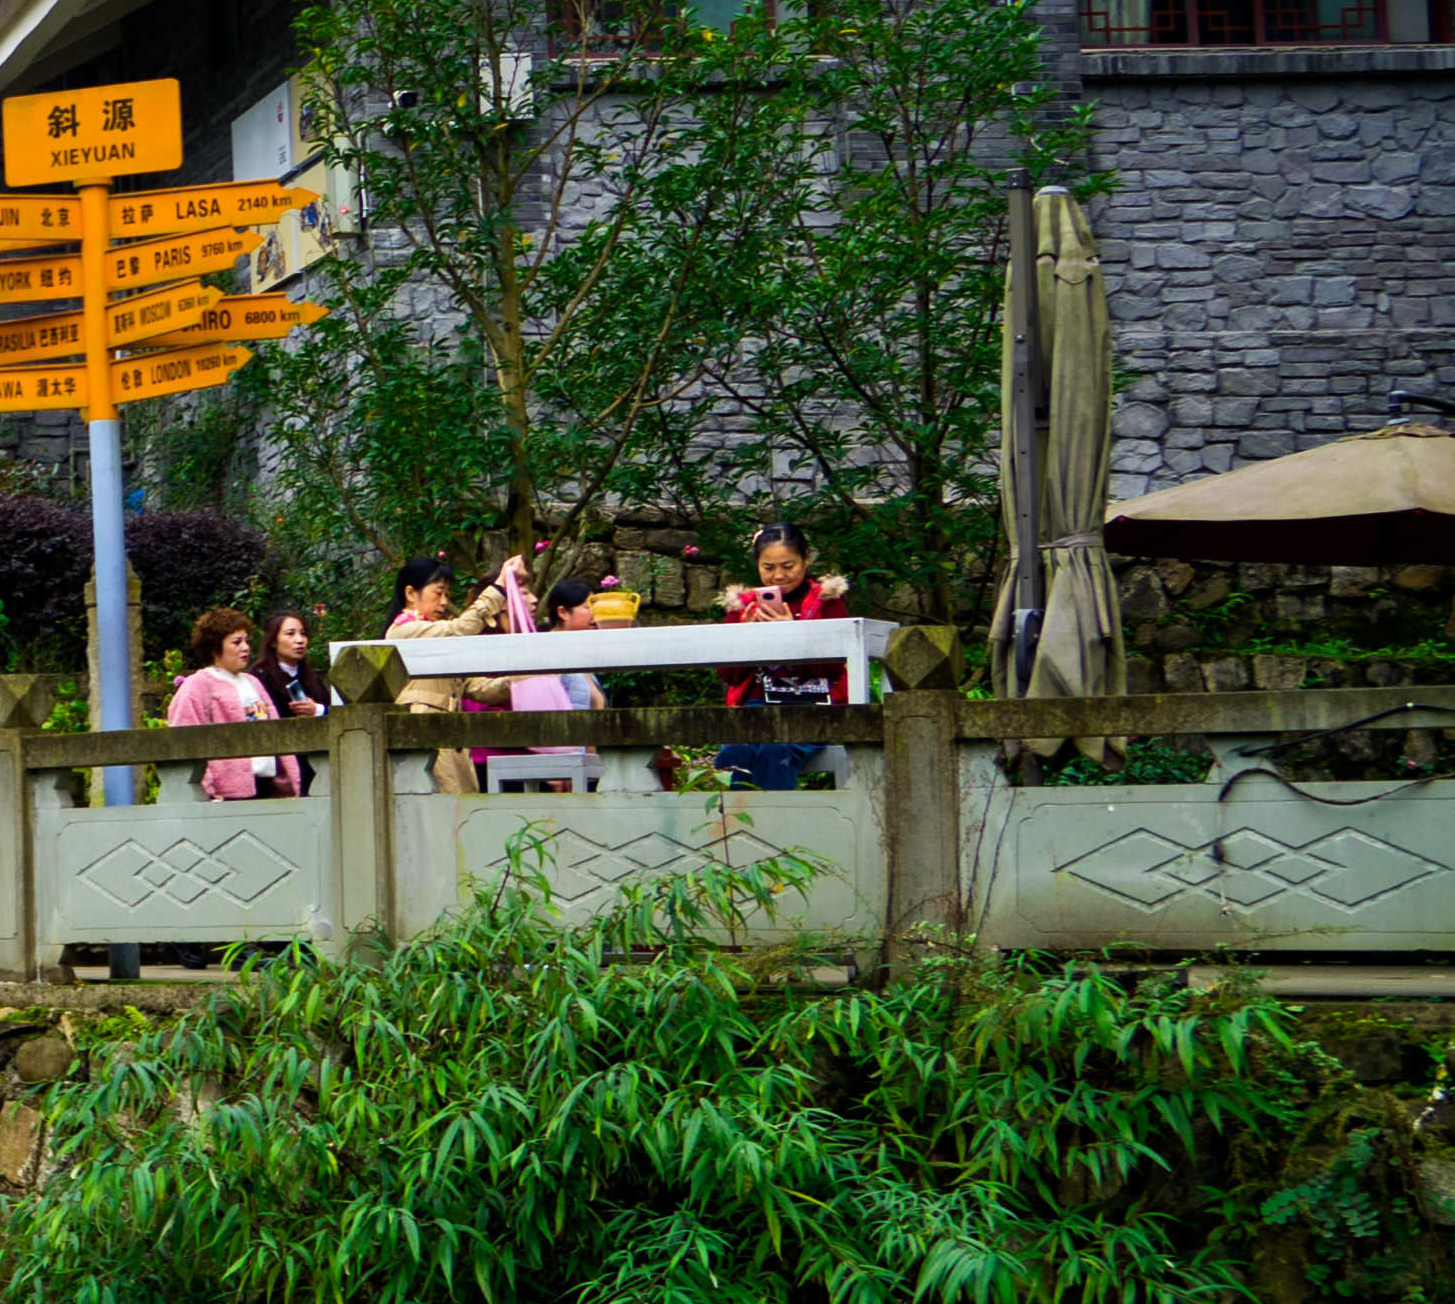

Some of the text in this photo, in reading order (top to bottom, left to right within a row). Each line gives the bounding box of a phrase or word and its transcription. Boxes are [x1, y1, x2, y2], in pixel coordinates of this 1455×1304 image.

[47, 98, 135, 138] 斜源
[51, 142, 135, 167] XIEYUAN
[40, 208, 70, 227] 北京
[122, 195, 292, 225] 拉萨 LASA 2140 km
[116, 239, 243, 278] 巴黎 PARIS 9760 km
[0, 271, 32, 290] YORK
[40, 268, 72, 287] 纽约
[140, 300, 171, 325] MOSCOW
[197, 294, 210, 306] km
[182, 309, 301, 332] IRO 6800 km
[121, 369, 142, 390] 伦敦
[151, 358, 191, 384] LONDON
[223, 353, 238, 366] km
[36, 377, 76, 397] 渥太华
